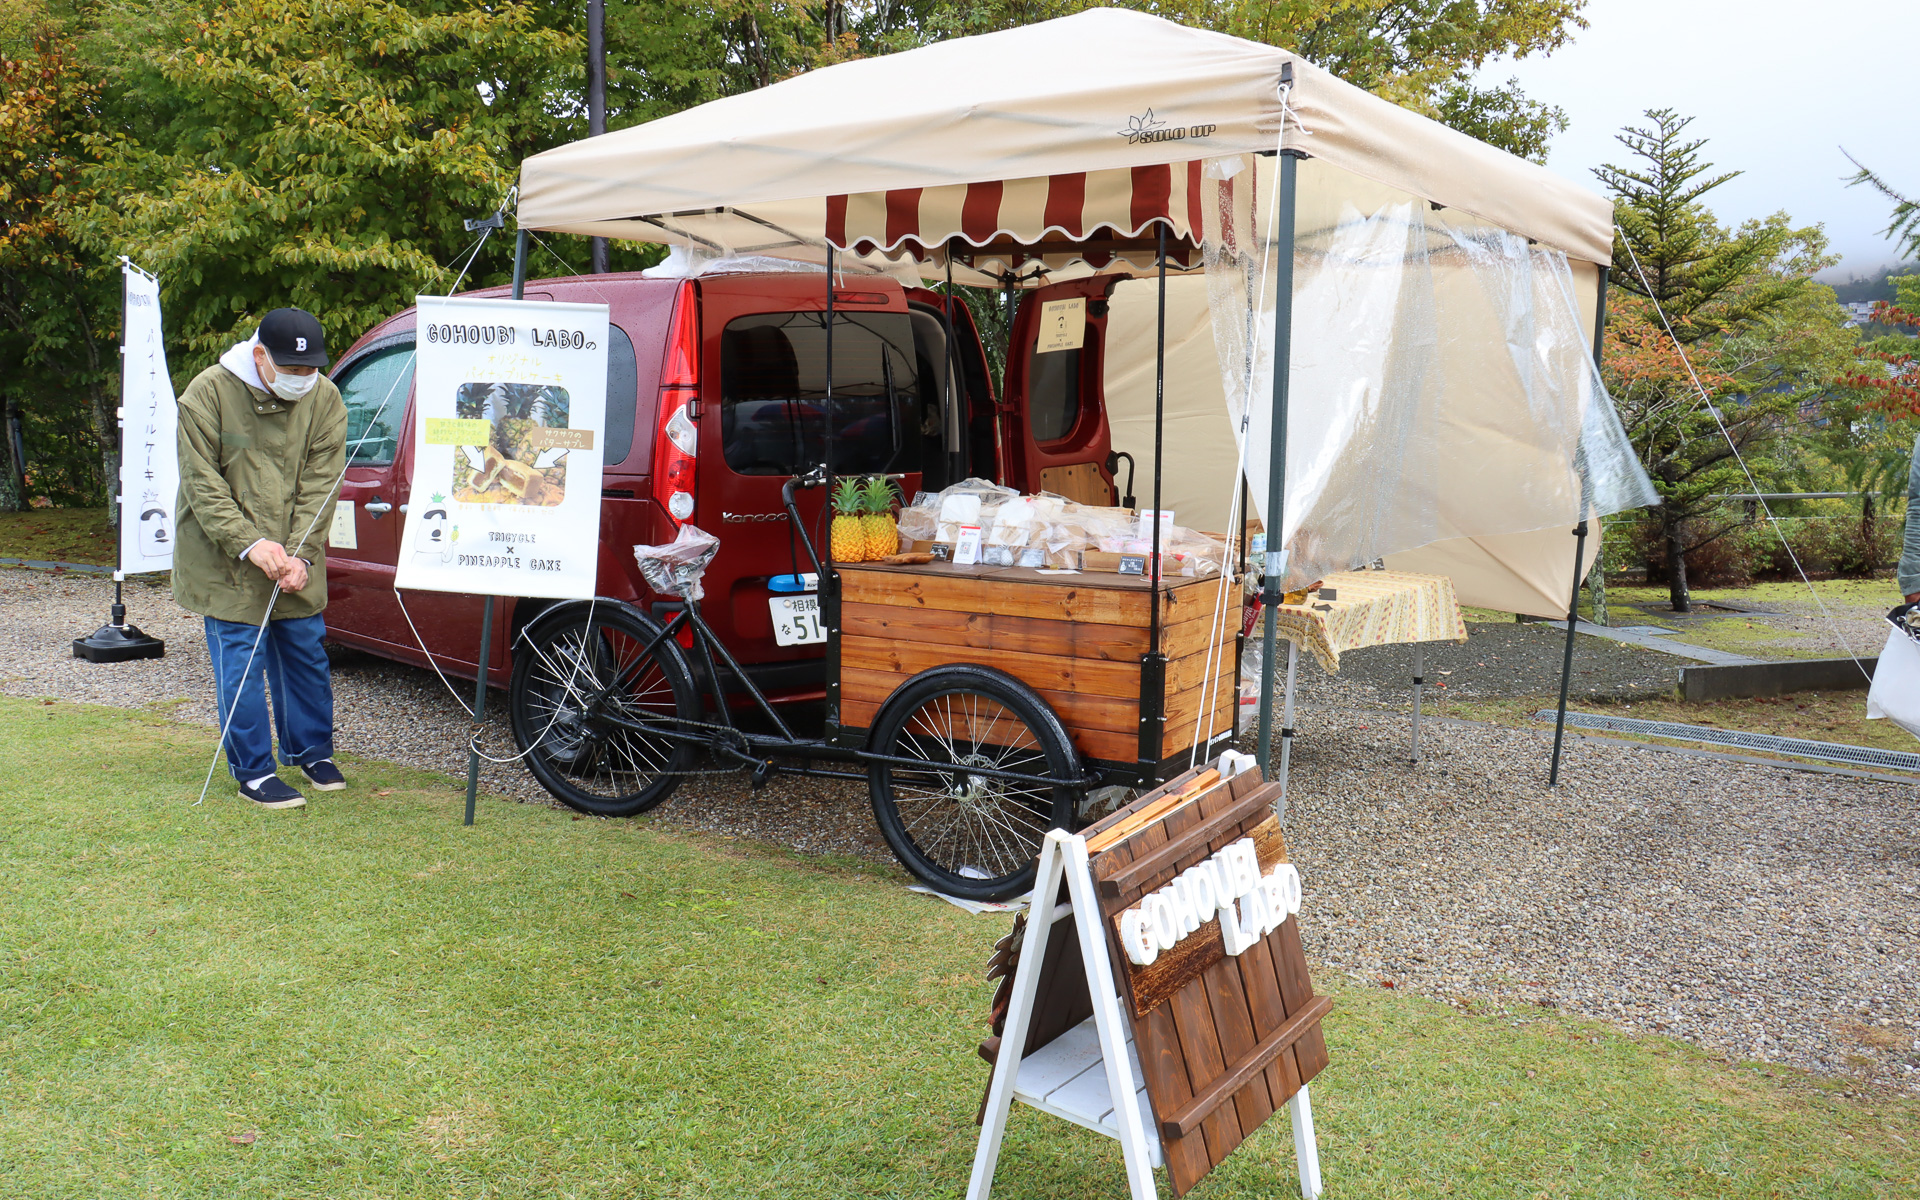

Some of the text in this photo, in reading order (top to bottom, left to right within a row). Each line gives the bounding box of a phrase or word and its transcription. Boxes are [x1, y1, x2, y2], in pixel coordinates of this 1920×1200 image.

[1139, 124, 1216, 144] SOLO UP
[426, 323, 515, 345] GOHOUBI
[295, 337, 307, 352] B
[487, 353, 543, 367] オリジナル
[465, 366, 564, 383] パイナップルケーキ
[144, 328, 158, 482] パイナップルケーキ
[544, 428, 582, 438] サクサクの
[539, 437, 586, 448] バターサブレ
[488, 531, 536, 544] TRICYCLE
[458, 554, 562, 572] PINEAPPLE CAKE
[791, 598, 818, 612] 相模
[781, 614, 820, 640] な 51
[1121, 837, 1262, 966] GOHOUBI
[1218, 863, 1302, 956] LABO
